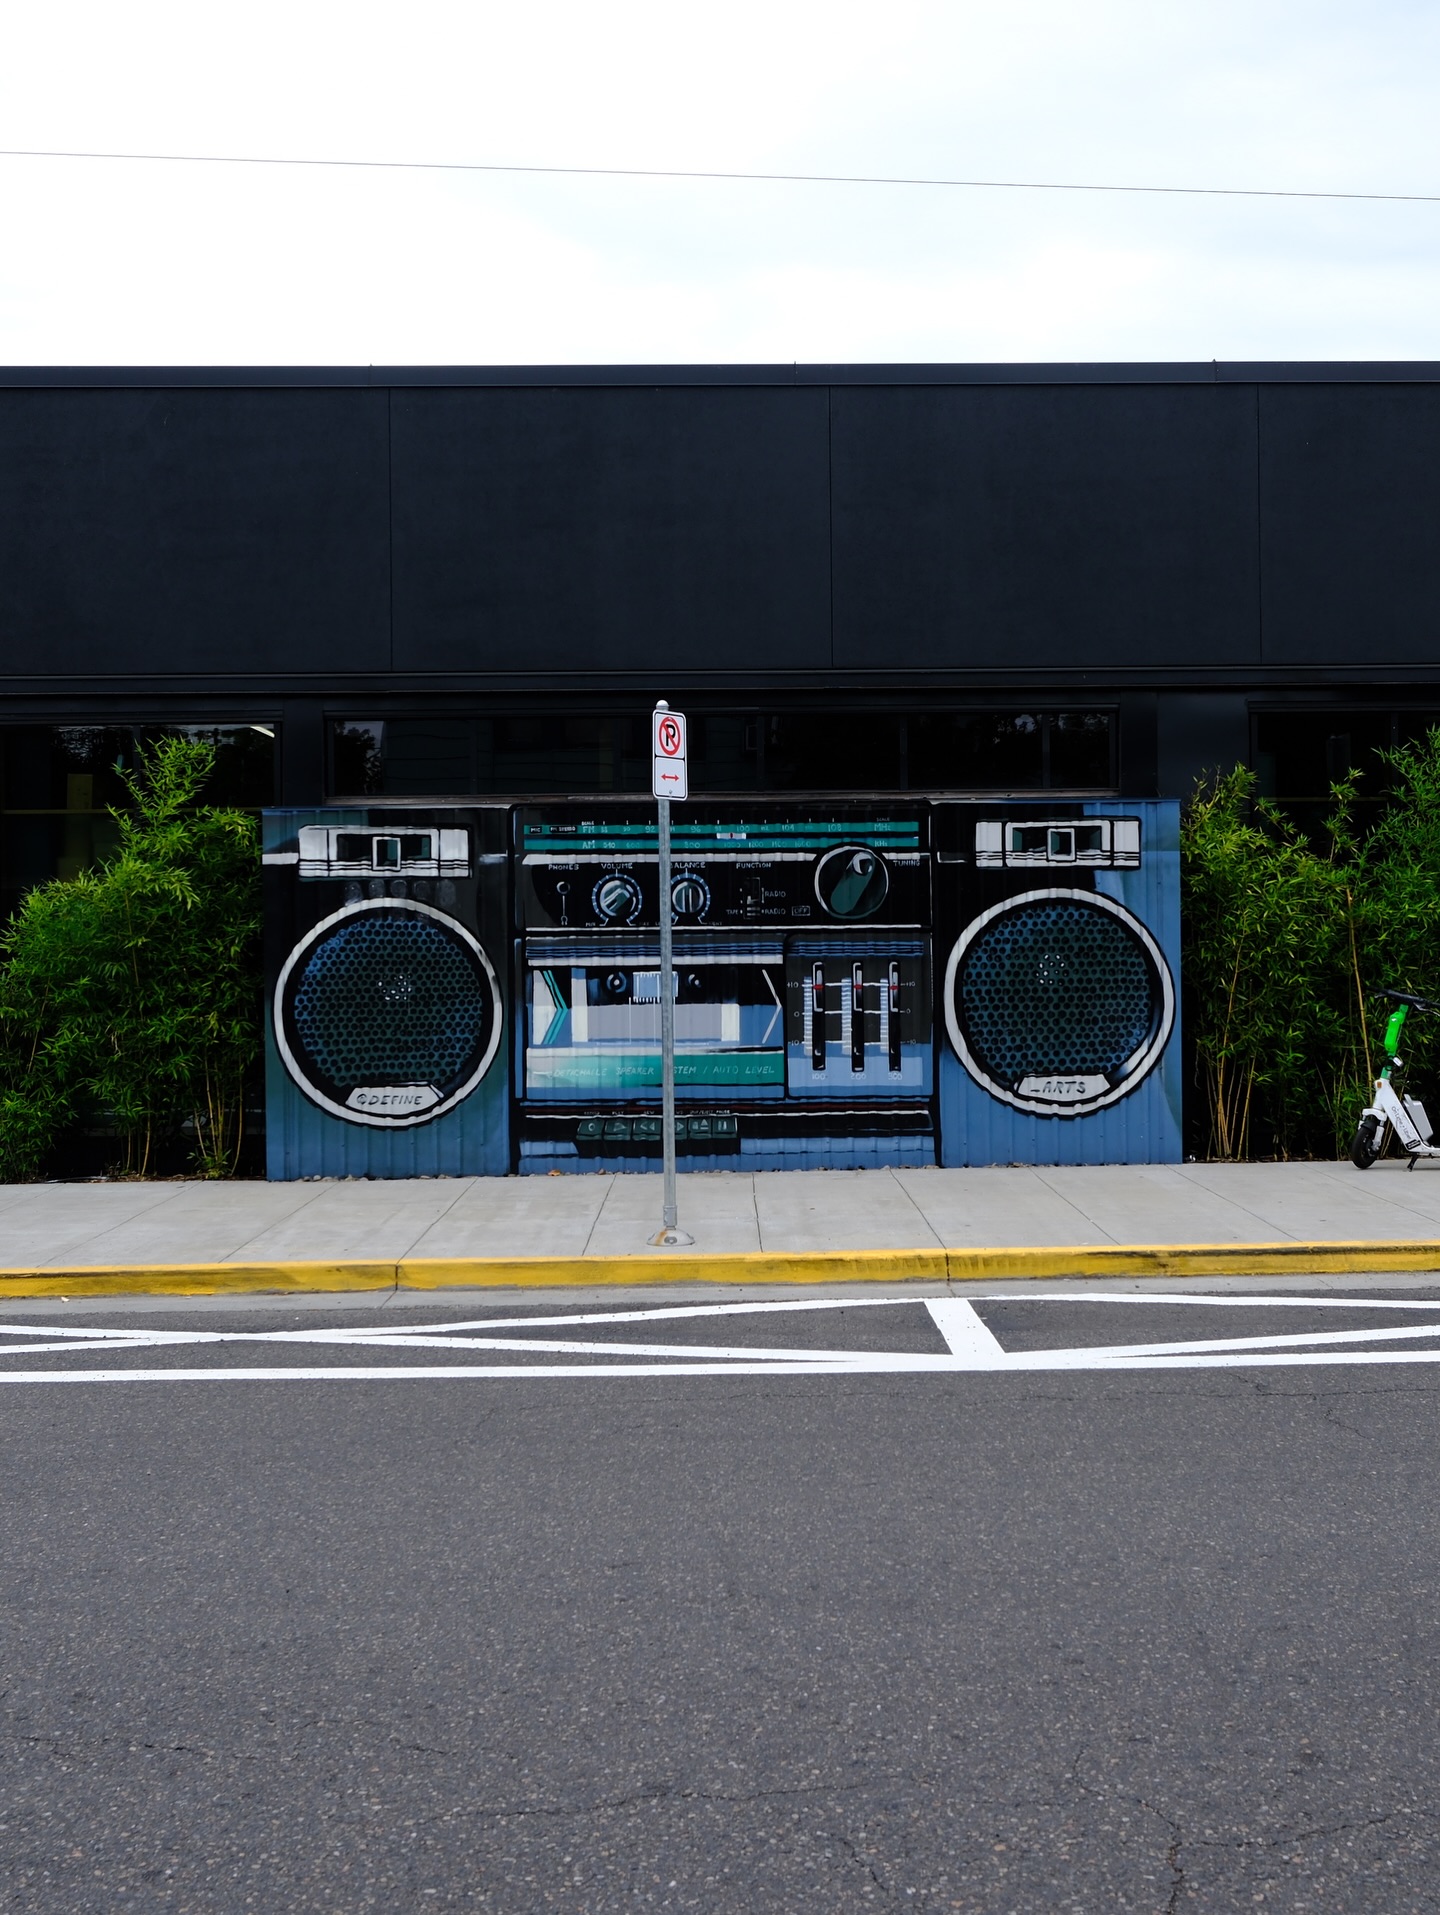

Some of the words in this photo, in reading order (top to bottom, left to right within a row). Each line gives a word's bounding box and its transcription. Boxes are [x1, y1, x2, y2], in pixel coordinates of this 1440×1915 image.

[582, 826, 595, 834] FM
[645, 825, 656, 834] 92
[690, 825, 702, 833] 96
[736, 824, 750, 832] 100
[781, 823, 795, 832] 104
[828, 823, 842, 832] 108
[582, 840, 596, 849] AM
[893, 859, 921, 867] TUNING
[764, 890, 786, 898] RADIO
[615, 1066, 654, 1075] SPEAKER
[713, 1065, 739, 1074] AUTO
[745, 1065, 775, 1074] LEVEL
[812, 1072, 826, 1080] 100
[851, 1072, 867, 1080] 200
